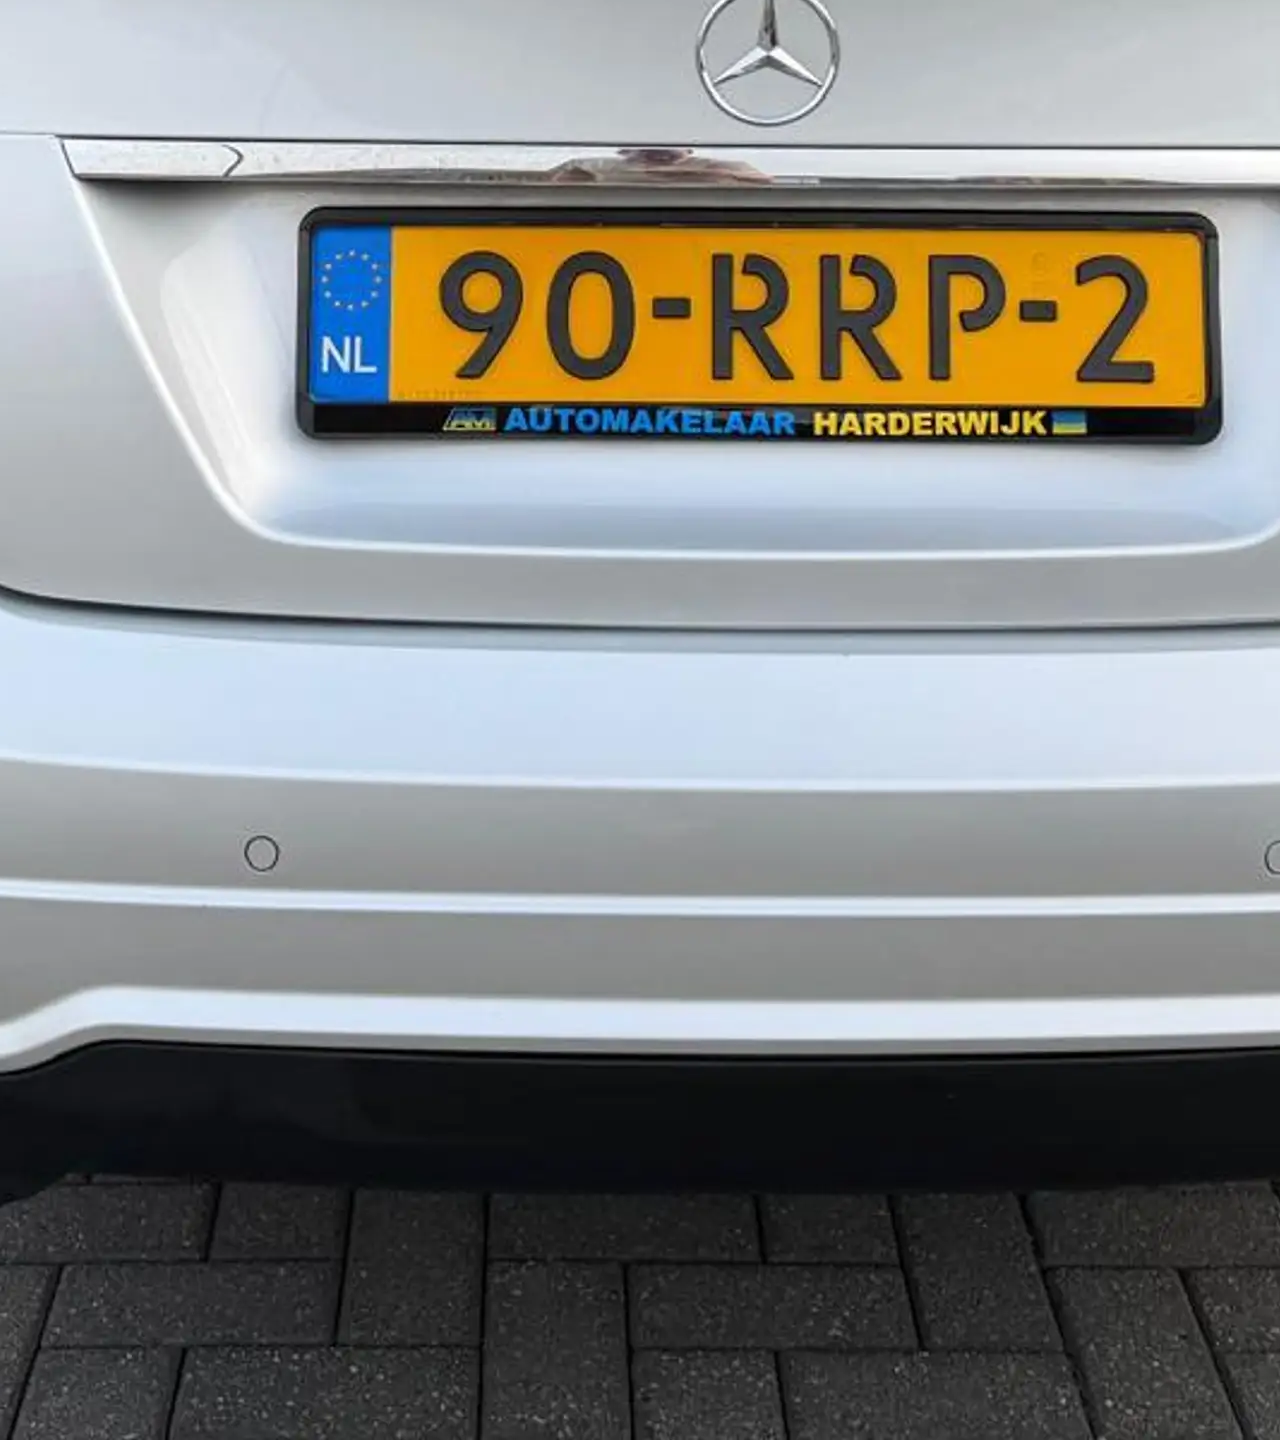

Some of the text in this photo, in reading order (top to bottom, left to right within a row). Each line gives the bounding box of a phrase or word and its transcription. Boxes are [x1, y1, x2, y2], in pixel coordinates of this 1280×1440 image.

[438, 250, 1155, 382] 90-RRP-2
[321, 335, 377, 374] NL
[503, 407, 1047, 436] AUTOMAKELAAR HARDERWIJK
